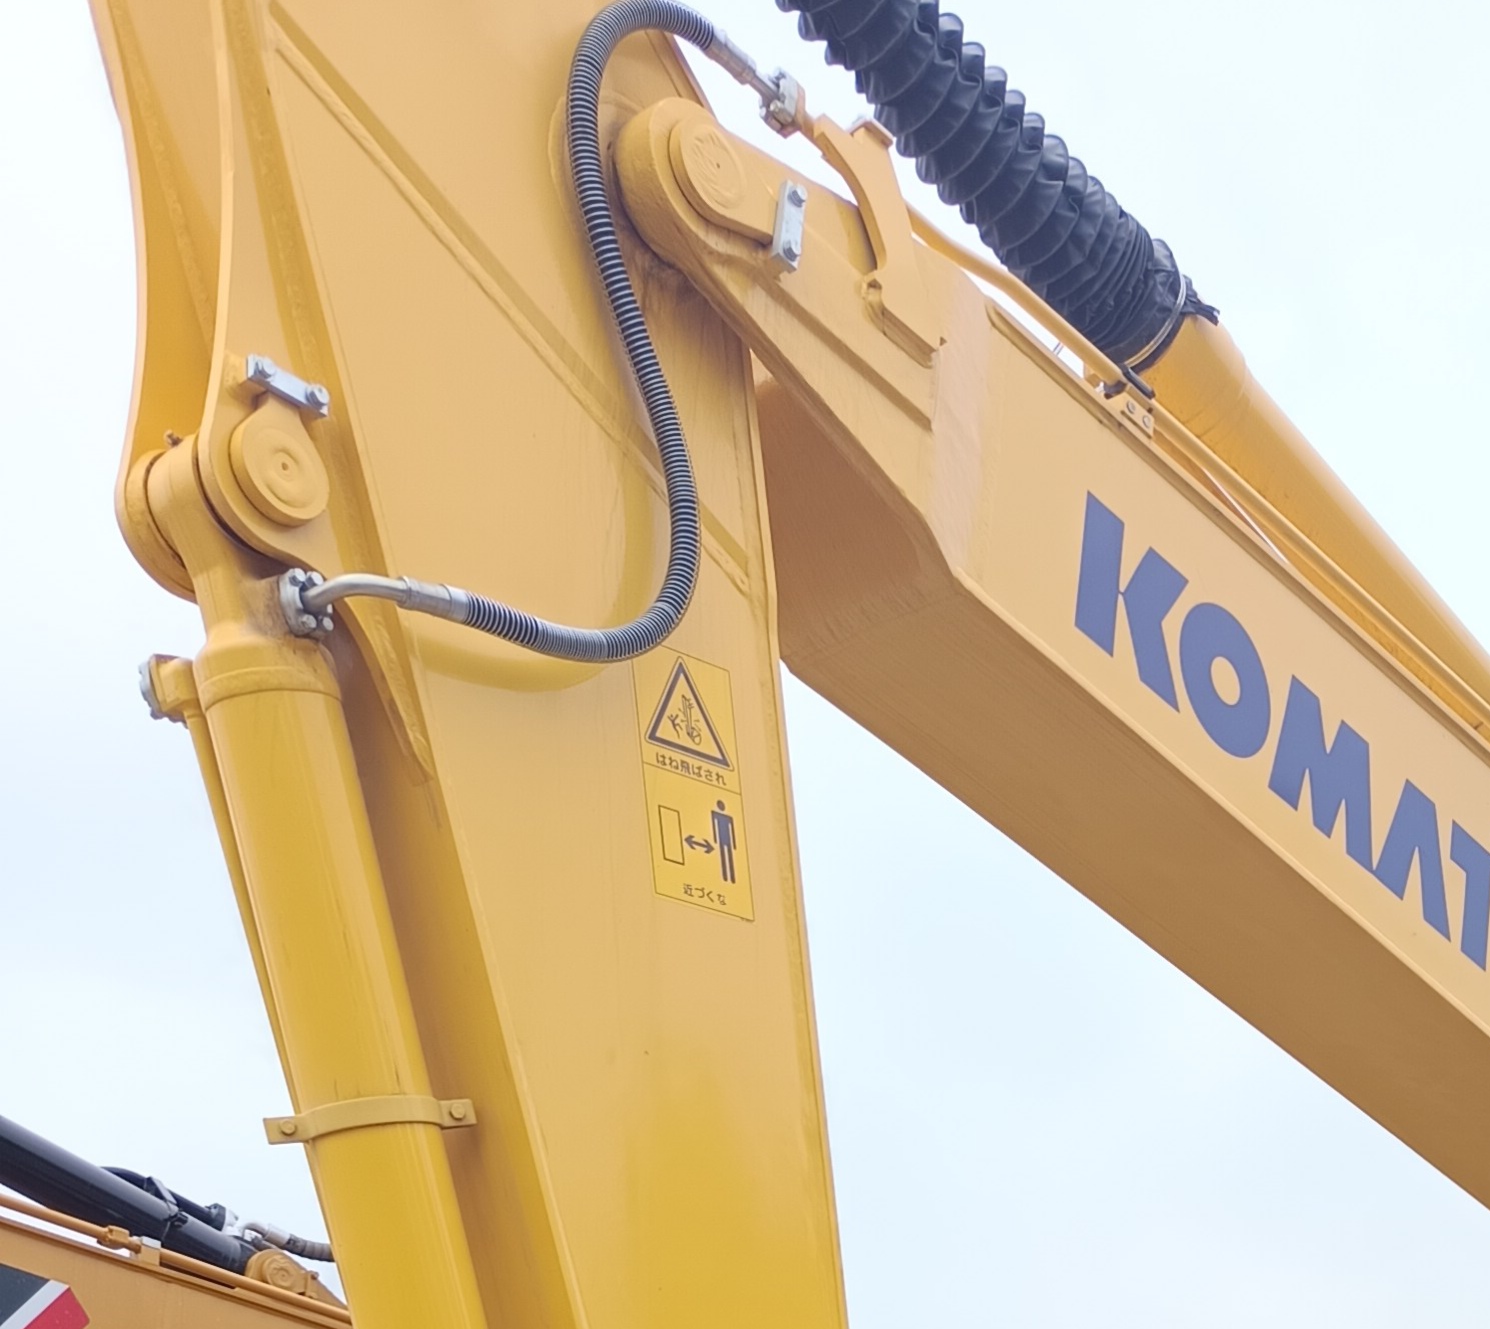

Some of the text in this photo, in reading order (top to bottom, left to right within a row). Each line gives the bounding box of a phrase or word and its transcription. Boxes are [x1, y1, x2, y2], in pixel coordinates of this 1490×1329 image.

[655, 751, 728, 787] はね飛ばされ
[682, 883, 728, 906] 近づくな
